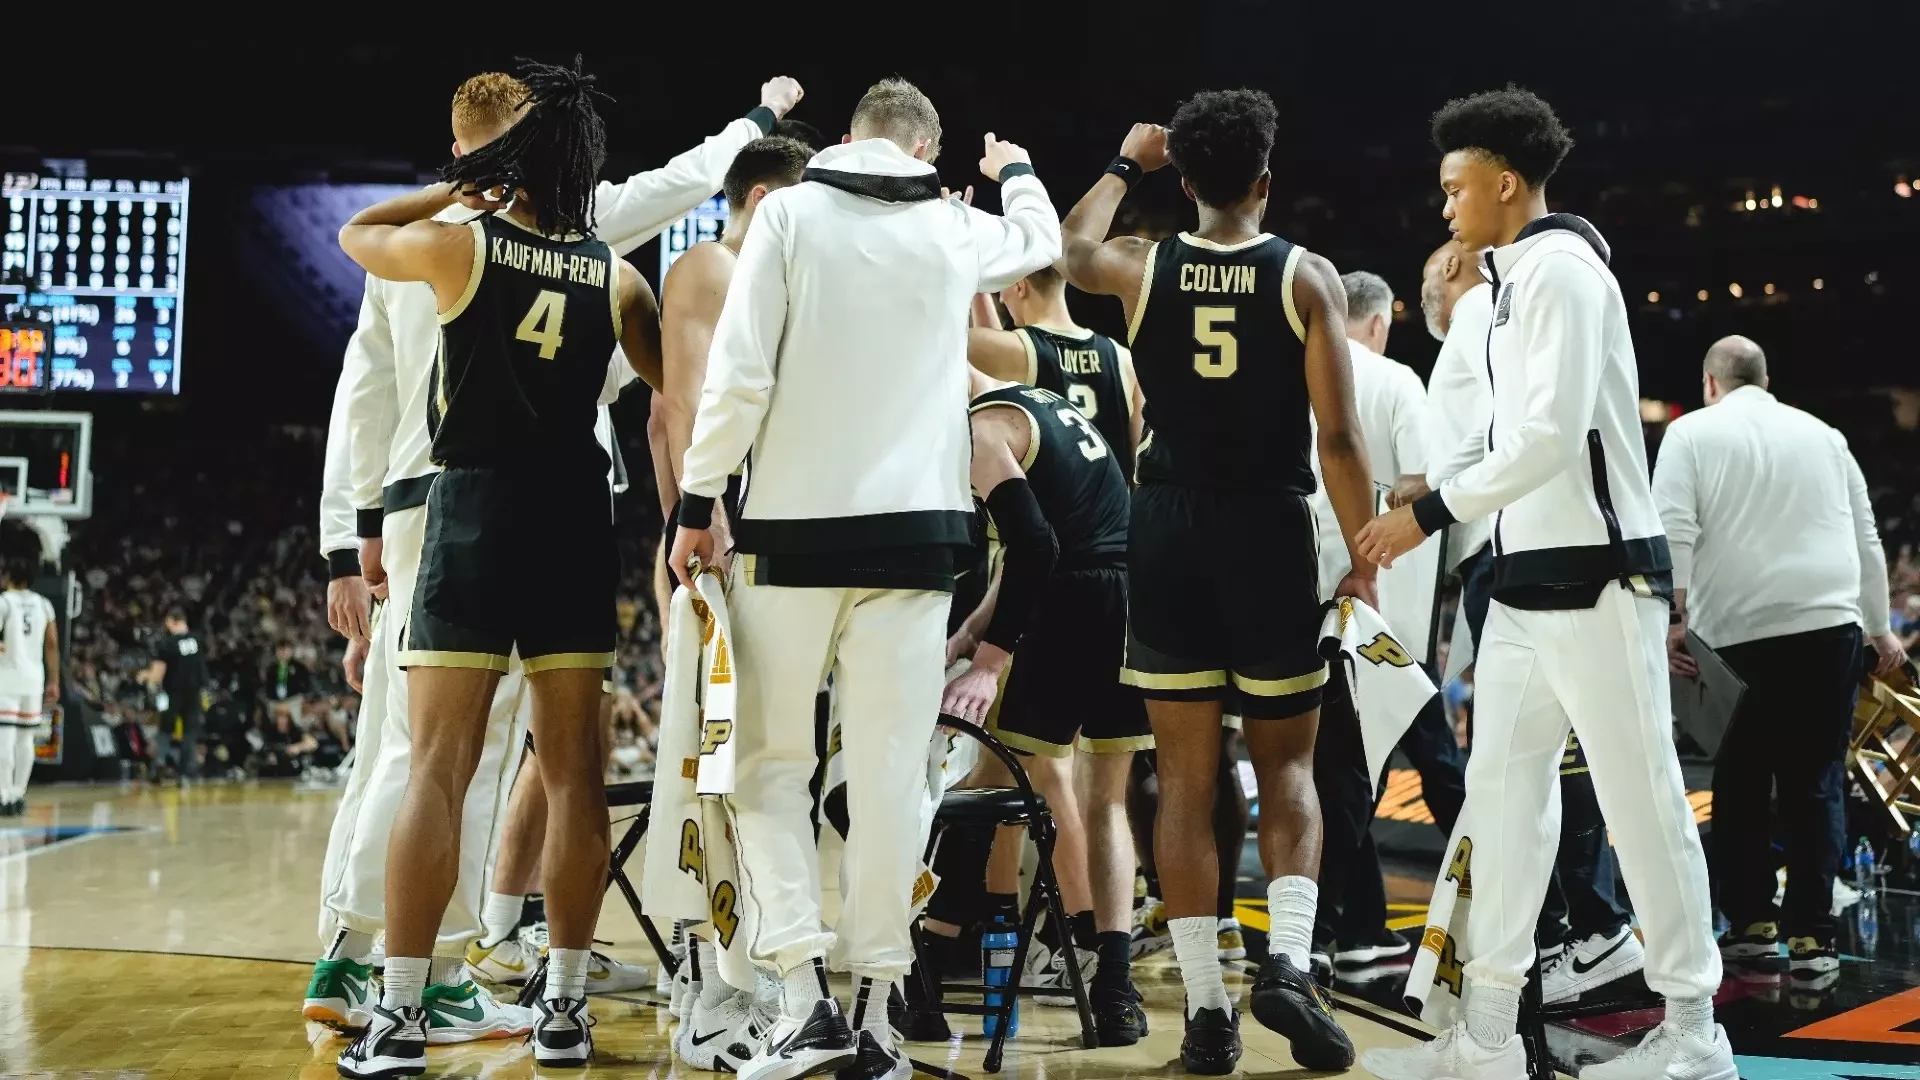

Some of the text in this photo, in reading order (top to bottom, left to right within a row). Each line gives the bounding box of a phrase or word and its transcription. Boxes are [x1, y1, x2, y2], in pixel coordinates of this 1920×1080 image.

[492, 237, 606, 288] KAUFMAN-RENN
[1180, 263, 1256, 293] COLVIN
[515, 289, 567, 361] 4
[1193, 306, 1237, 378] 5
[1056, 346, 1102, 374] LOYER
[1056, 408, 1107, 462] 3
[1356, 631, 1415, 668] P
[700, 719, 733, 755] P
[678, 818, 704, 885] P
[712, 879, 740, 950] P
